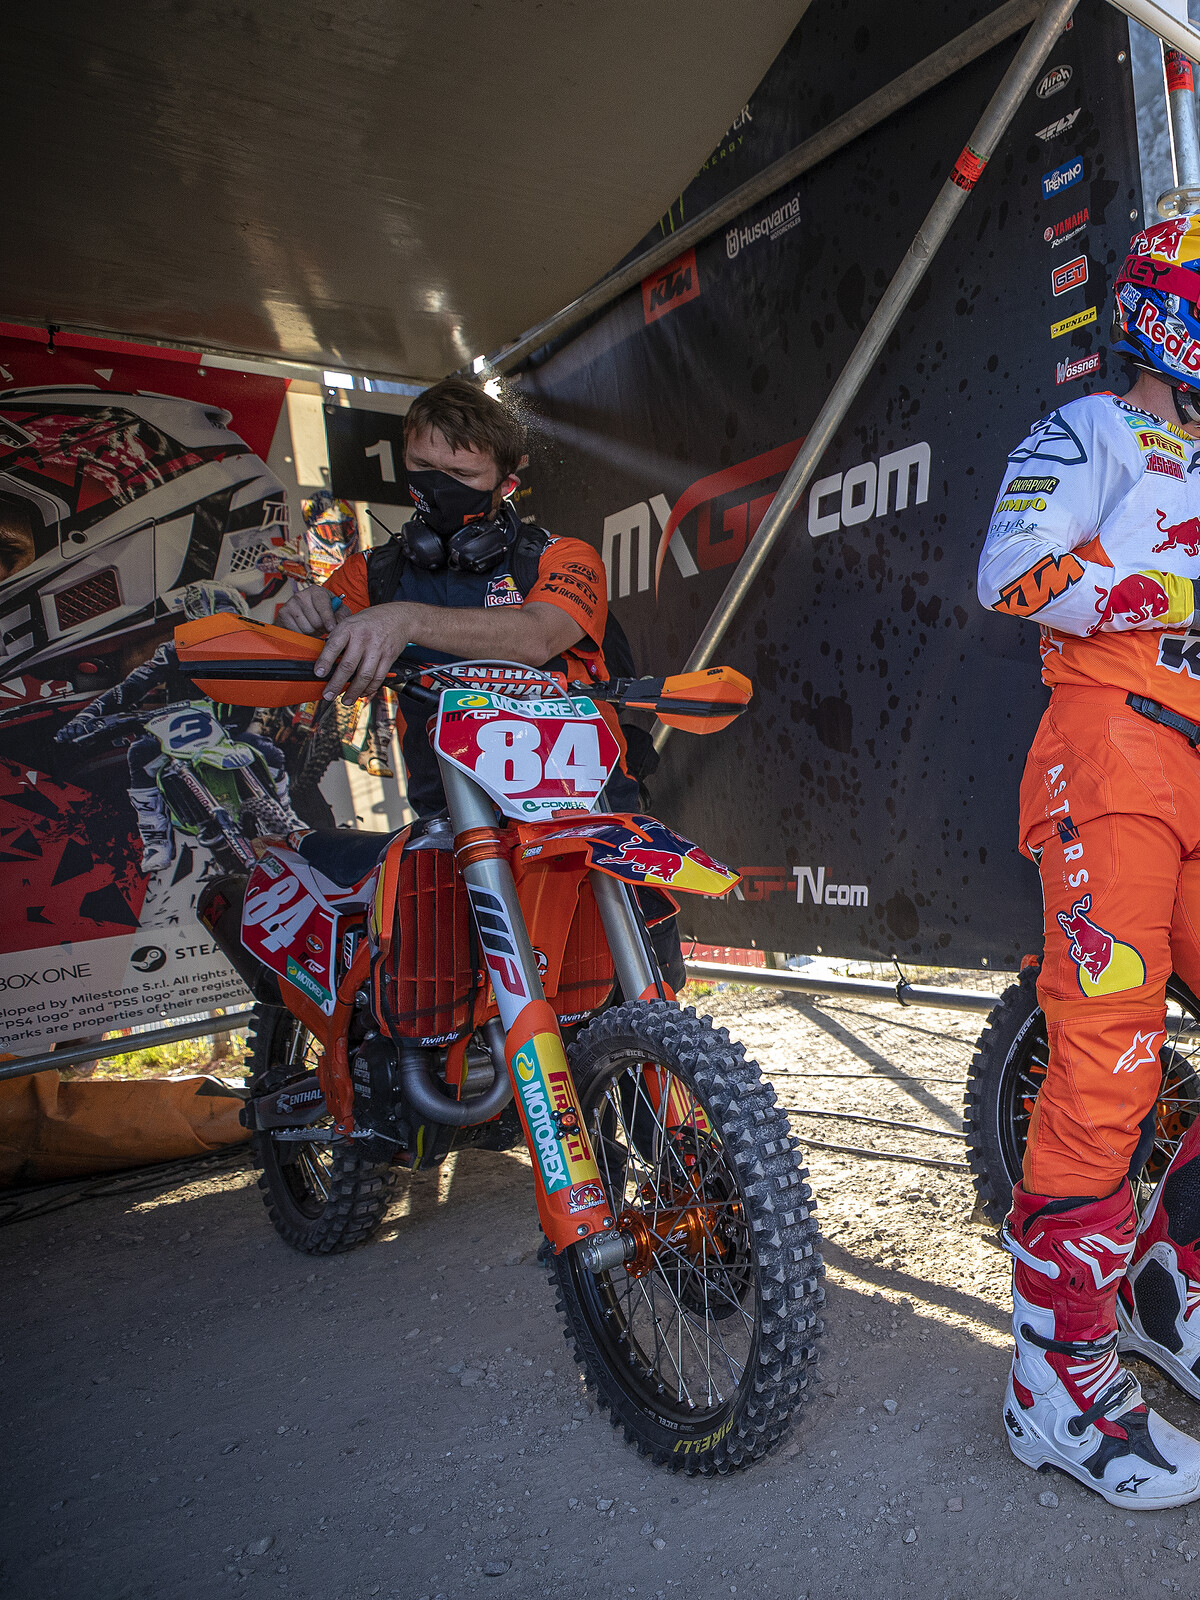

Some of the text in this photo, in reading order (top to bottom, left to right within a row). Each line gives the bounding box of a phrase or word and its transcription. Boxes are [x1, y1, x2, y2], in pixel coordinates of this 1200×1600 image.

[1040, 67, 1070, 95] Airoh
[1035, 107, 1081, 139] FLY
[697, 135, 744, 177] NERGY
[1043, 163, 1082, 193] TRENTINO
[738, 198, 800, 249] Husqvarna
[1053, 208, 1089, 236] YAMAHA
[1055, 263, 1084, 288] GET
[1121, 258, 1172, 286] KLEY
[649, 264, 692, 314] KTM
[1058, 311, 1096, 332] DUNLOP
[1136, 301, 1189, 357] Red
[1056, 356, 1099, 384] Wössner
[1139, 432, 1184, 459] PIRELLI
[365, 439, 397, 483] 1
[409, 484, 424, 499] READY
[996, 497, 1047, 513] UMBO
[991, 553, 1085, 617] KTM
[487, 592, 513, 607] Red
[445, 709, 499, 723] MXGP
[490, 694, 583, 717] MOTOREX
[475, 720, 608, 794] 84
[1046, 763, 1090, 889] ASTRS
[243, 875, 318, 954] 84
[175, 943, 222, 960] STEA
[42, 963, 92, 983] ONE
[296, 972, 324, 1000] MOTOREX
[49, 1000, 67, 1009] by
[71, 986, 139, 1004] Milestone
[142, 979, 170, 991] S.r.l.
[173, 976, 189, 986] All
[192, 969, 228, 982] rights
[79, 1003, 105, 1015] and
[178, 987, 198, 997] are
[46, 1024, 68, 1034] are
[73, 1009, 143, 1031] properties
[147, 1004, 160, 1014] of
[163, 998, 192, 1011] their
[559, 1014, 581, 1022] Twin
[421, 1032, 459, 1045] Twin Air
[276, 1088, 323, 1114] RENTHAL
[548, 1071, 591, 1163] PIRLLI
[522, 1080, 568, 1188] MOTOREX
[659, 1416, 679, 1431] EXCEL
[673, 1413, 735, 1455] PIRELLI
